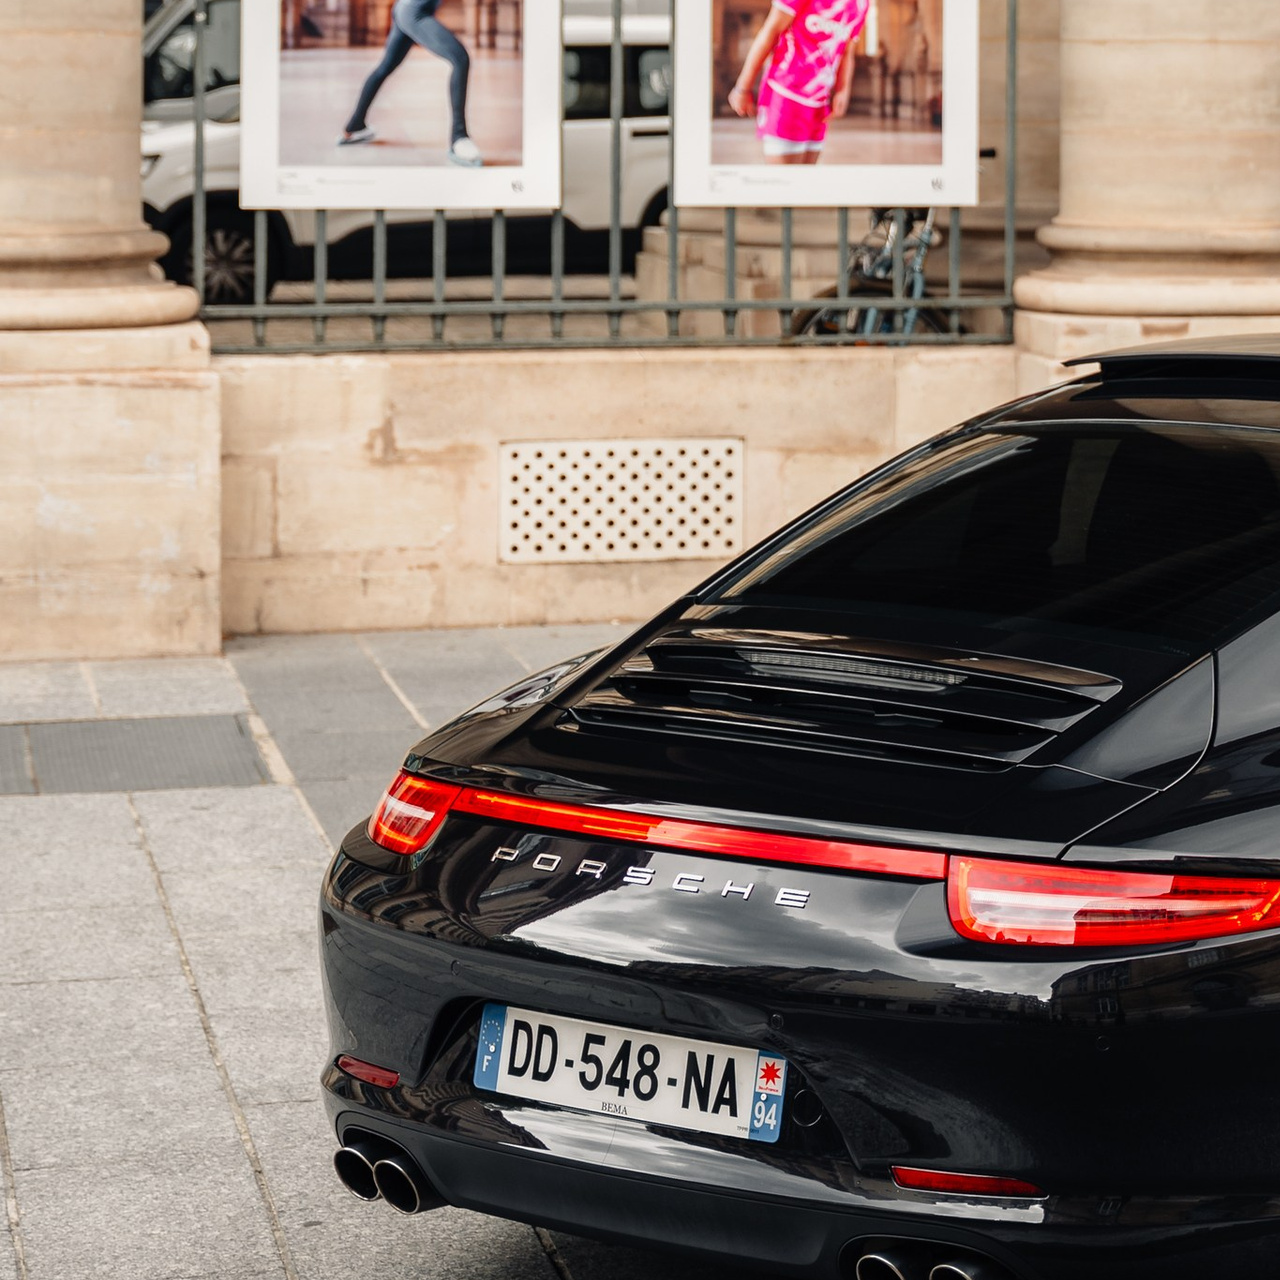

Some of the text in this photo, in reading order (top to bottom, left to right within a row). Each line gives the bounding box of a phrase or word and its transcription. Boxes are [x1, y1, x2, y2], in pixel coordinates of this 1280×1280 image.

[491, 846, 811, 909] PORSCHE
[482, 1055, 492, 1072] F
[507, 1019, 738, 1118] DD-548-NA
[601, 1101, 628, 1115] BEMA
[754, 1101, 777, 1130] 94
